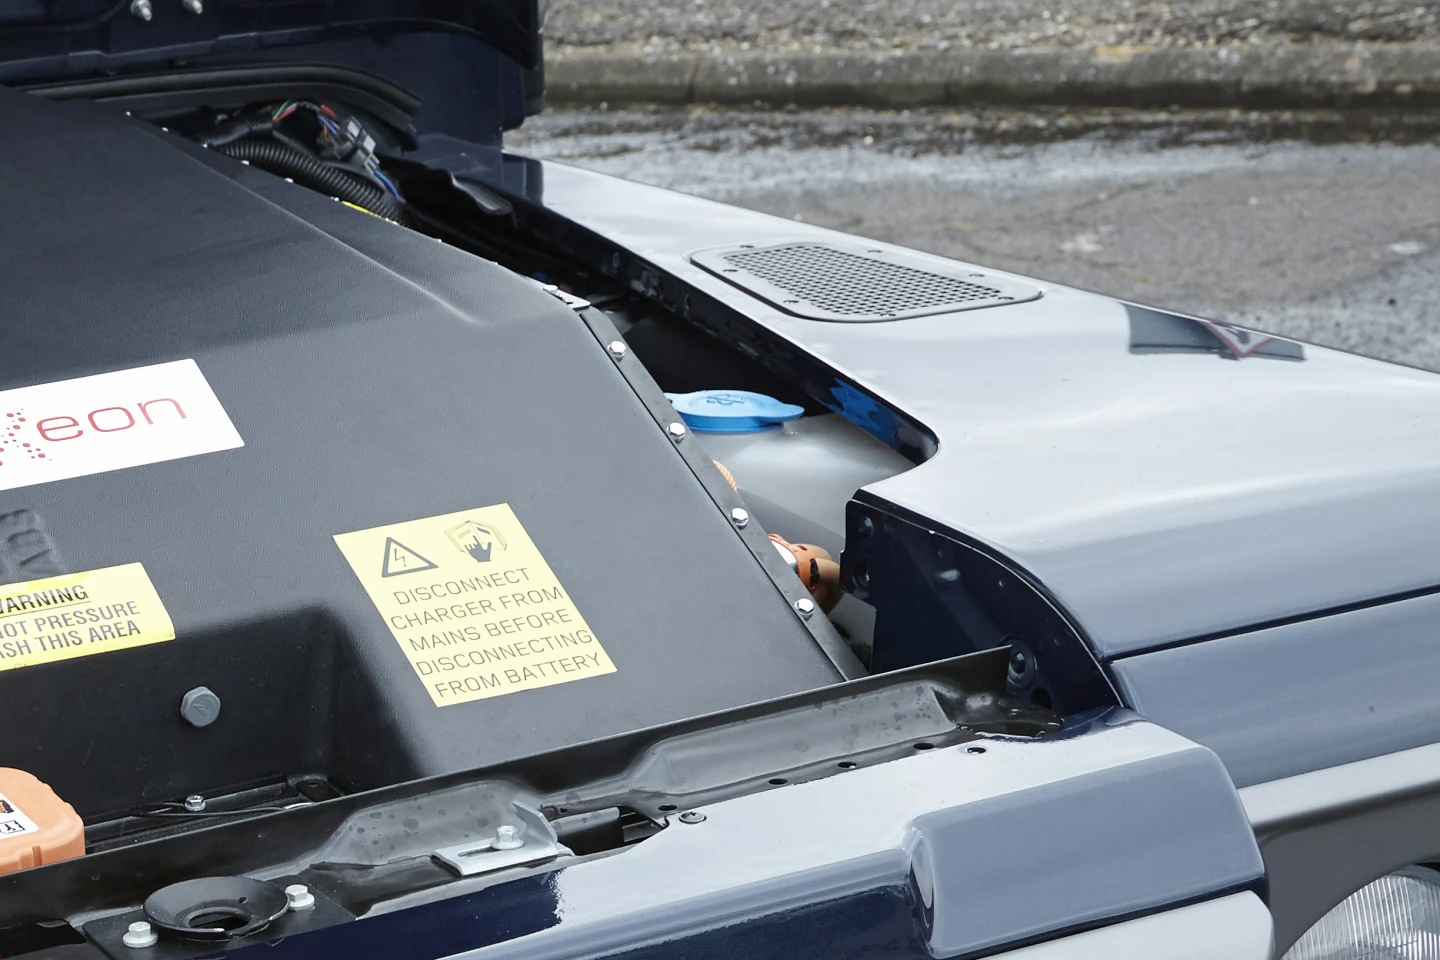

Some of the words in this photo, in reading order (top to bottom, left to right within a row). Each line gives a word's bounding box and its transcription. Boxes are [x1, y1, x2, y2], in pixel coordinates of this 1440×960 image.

[390, 599, 495, 630] CHARGER
[499, 586, 564, 610] FROM
[393, 567, 531, 605] DISCONNECT
[35, 601, 141, 632] PRESSURE
[35, 630, 84, 652] THIS
[89, 620, 141, 642] AREA
[409, 626, 481, 652] MAINS
[484, 608, 573, 637] BEFORE
[416, 629, 593, 676] DISCONNECTING
[435, 672, 502, 698] FROM
[505, 652, 602, 684] BATTERY
